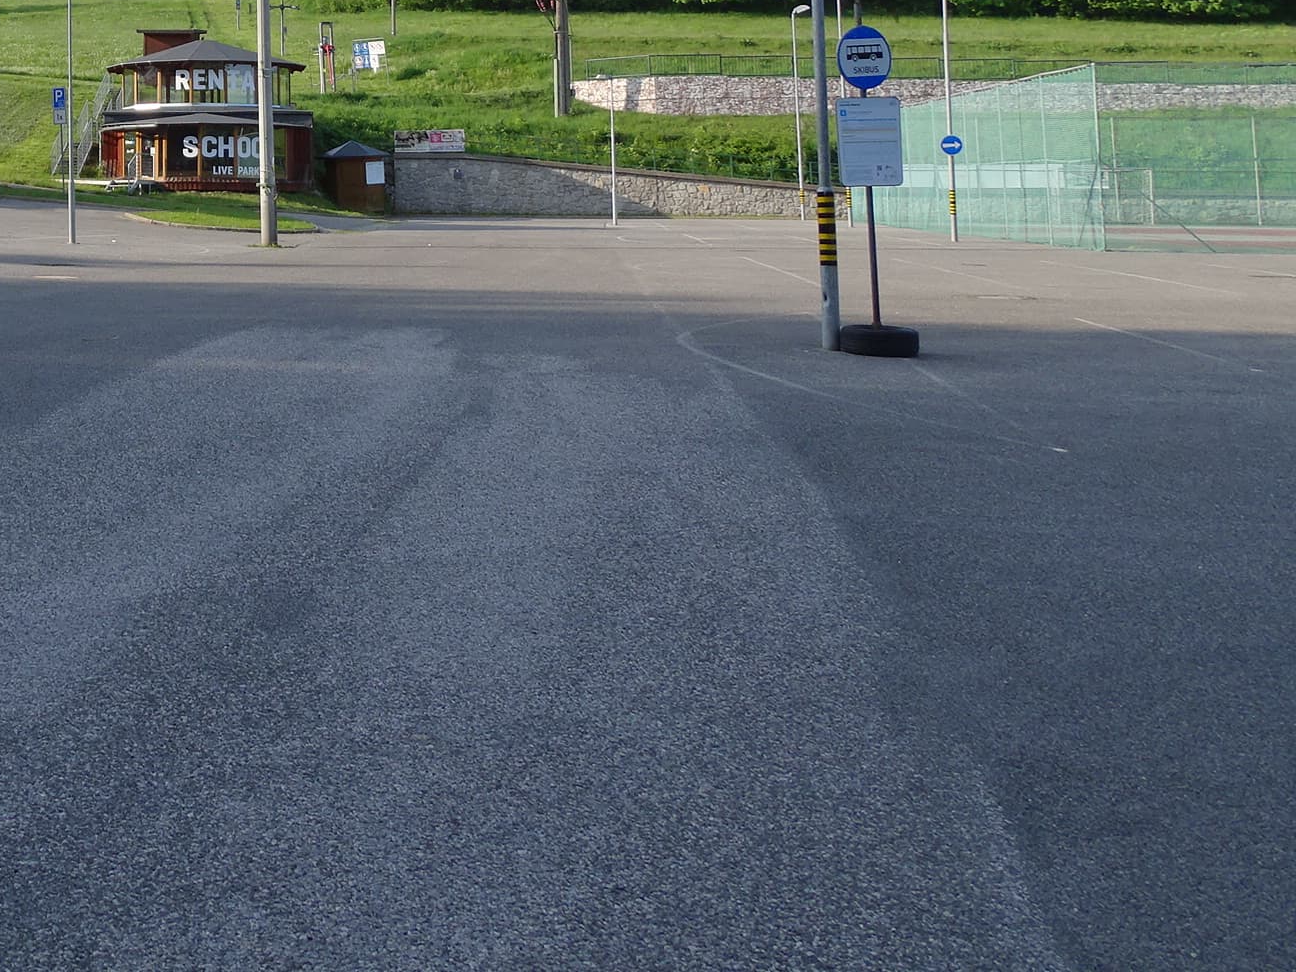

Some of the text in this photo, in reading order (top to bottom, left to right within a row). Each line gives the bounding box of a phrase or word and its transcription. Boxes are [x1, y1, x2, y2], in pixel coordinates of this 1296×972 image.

[853, 66, 880, 74] SKIBUS
[175, 69, 256, 91] RENTA
[55, 90, 63, 103] P
[182, 135, 260, 158] SCHOO
[212, 165, 233, 175] LIVE
